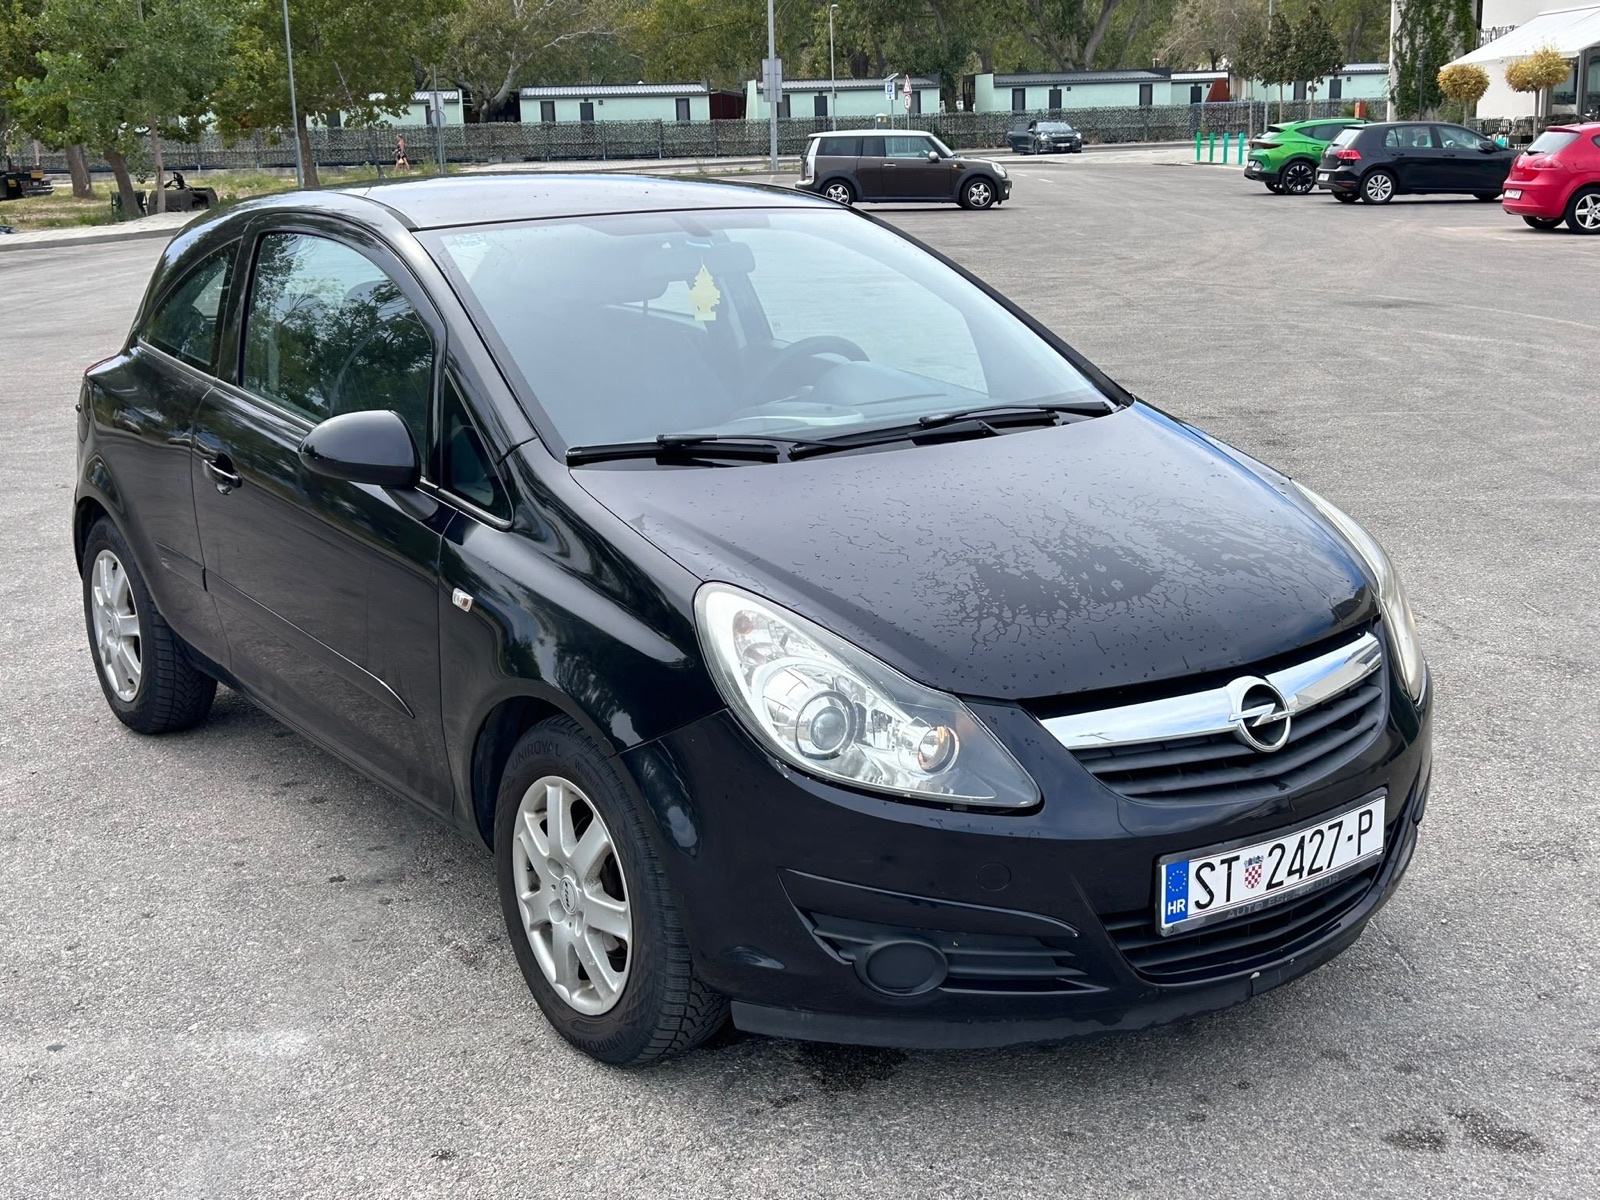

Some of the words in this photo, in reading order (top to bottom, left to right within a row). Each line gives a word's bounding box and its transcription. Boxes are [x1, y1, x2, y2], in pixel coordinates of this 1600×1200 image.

[1194, 854, 1241, 910] ST
[1265, 808, 1374, 891] 2427-P
[1167, 898, 1186, 915] HR
